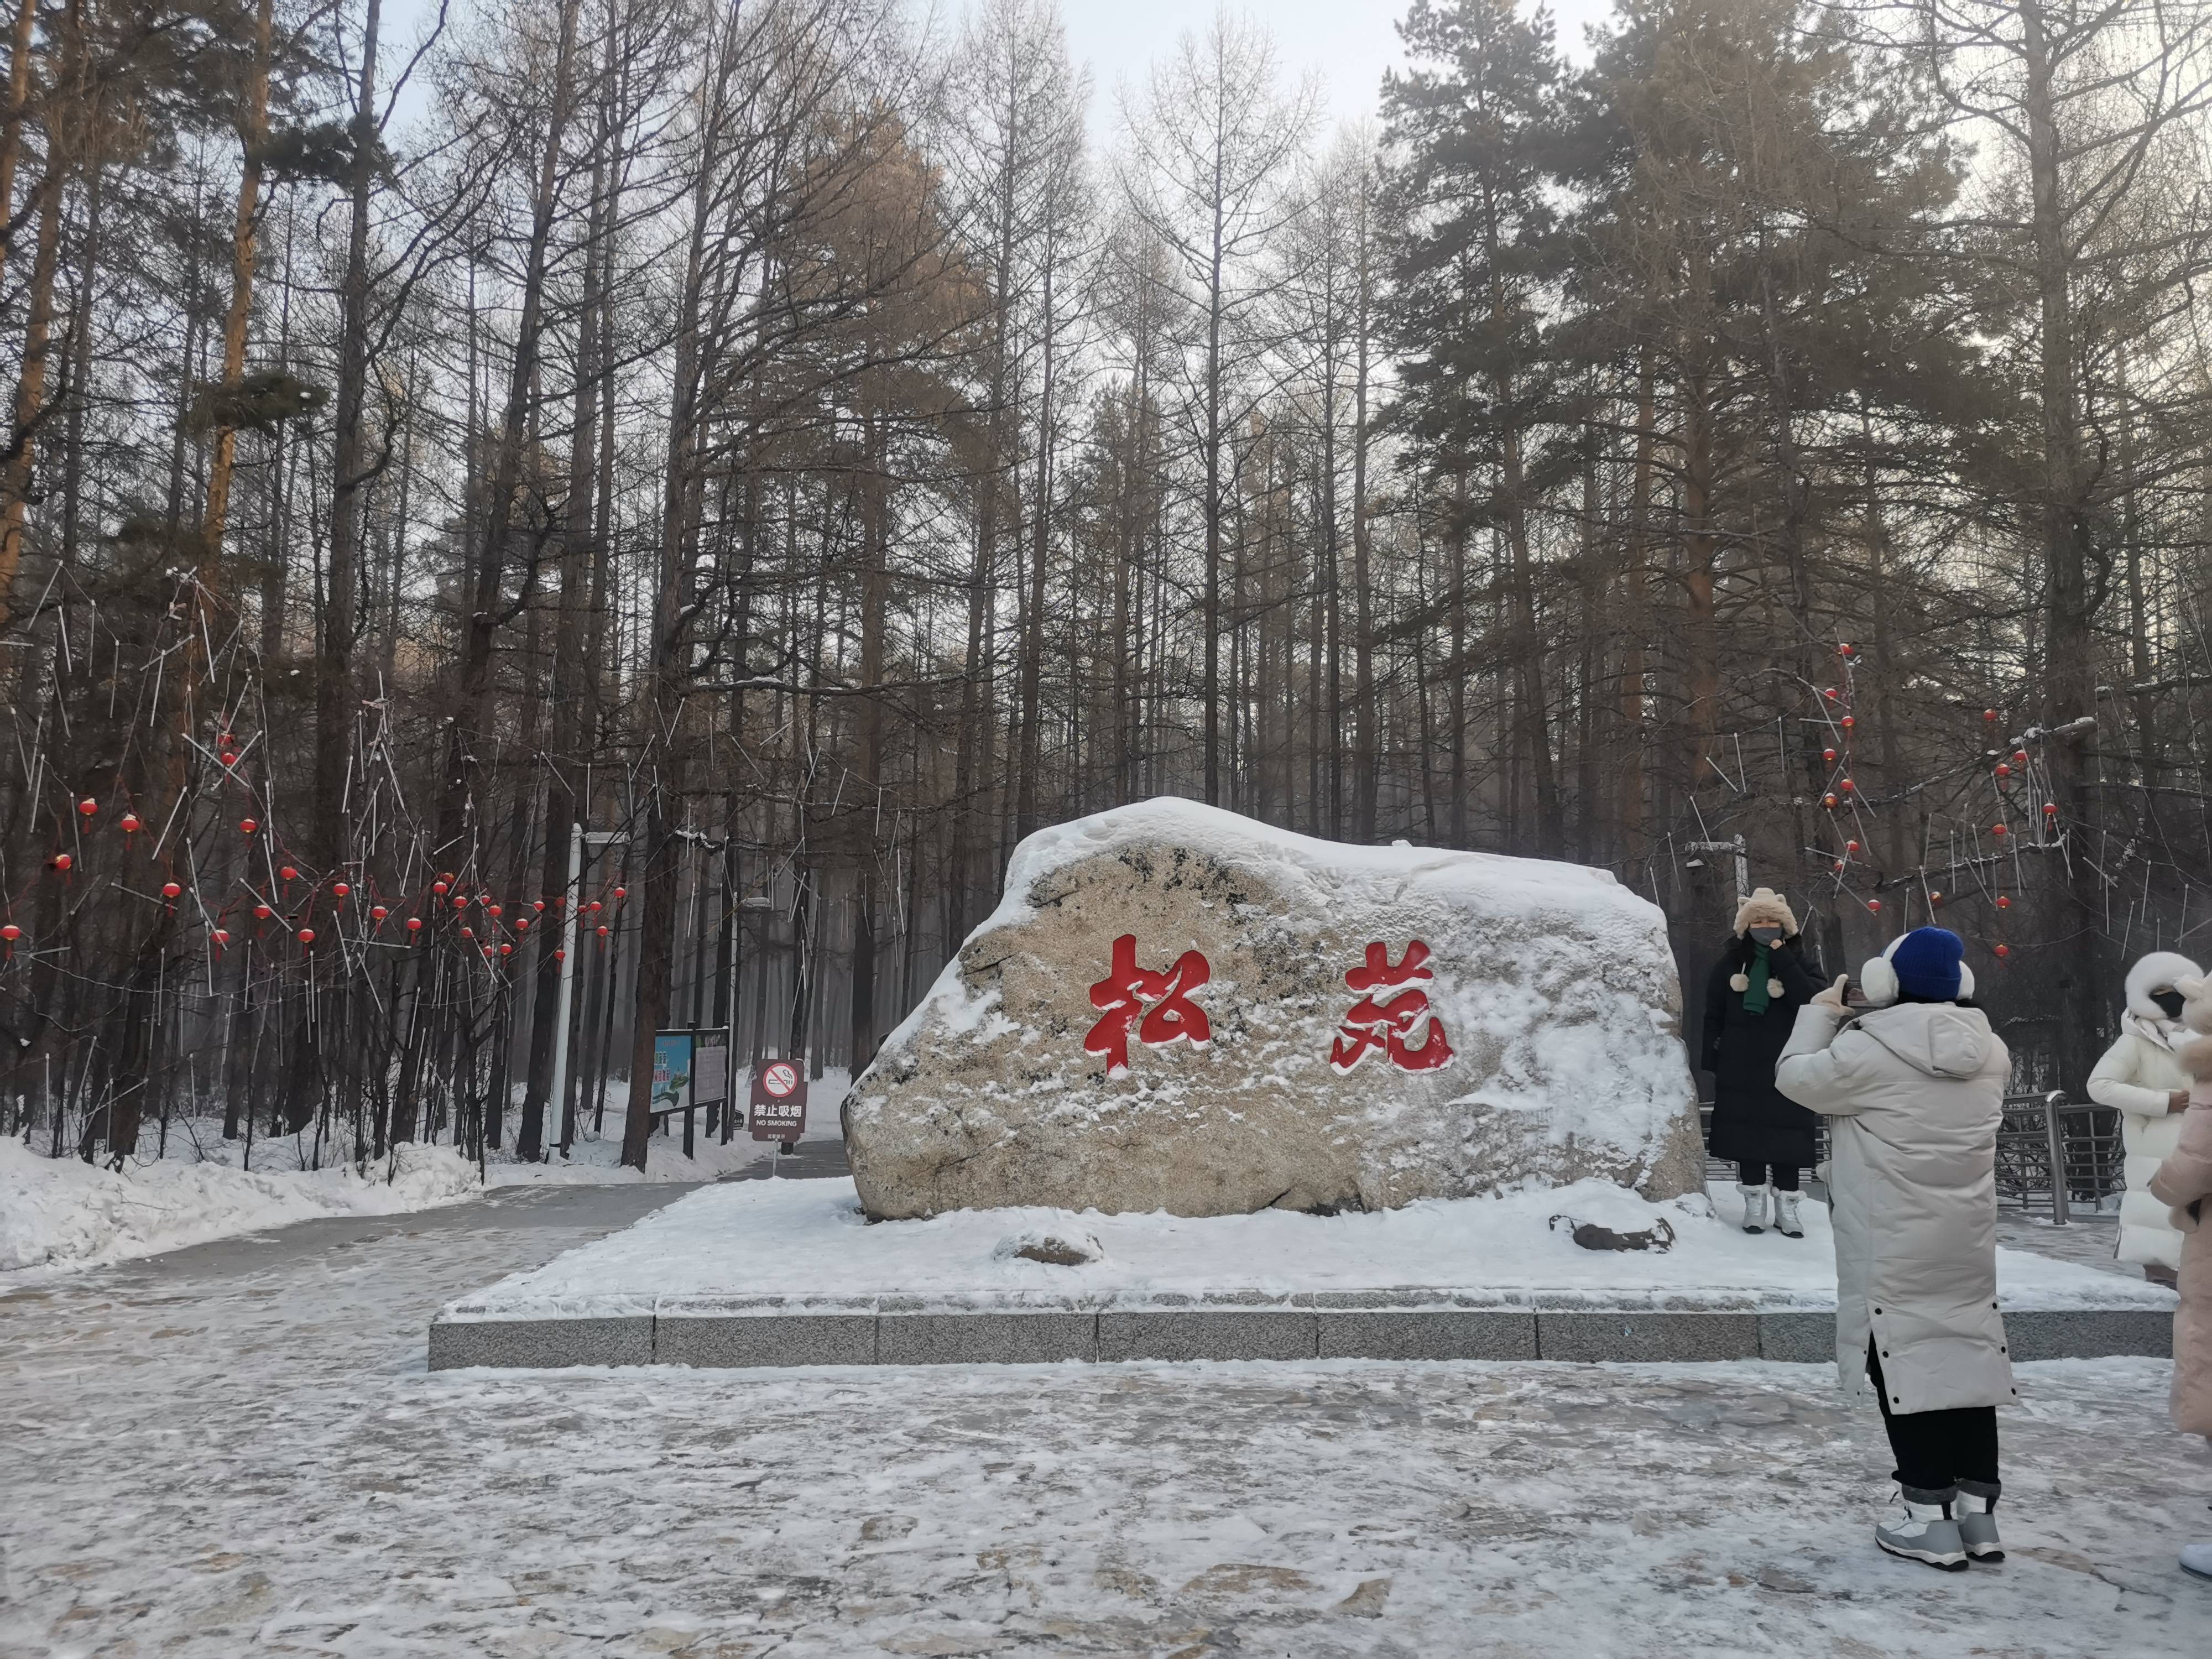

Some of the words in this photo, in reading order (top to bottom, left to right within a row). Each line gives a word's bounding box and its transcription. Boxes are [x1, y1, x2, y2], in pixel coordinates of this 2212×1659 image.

[1084, 934, 1454, 1076] 松苑
[754, 1104, 802, 1117] 禁止吸烟
